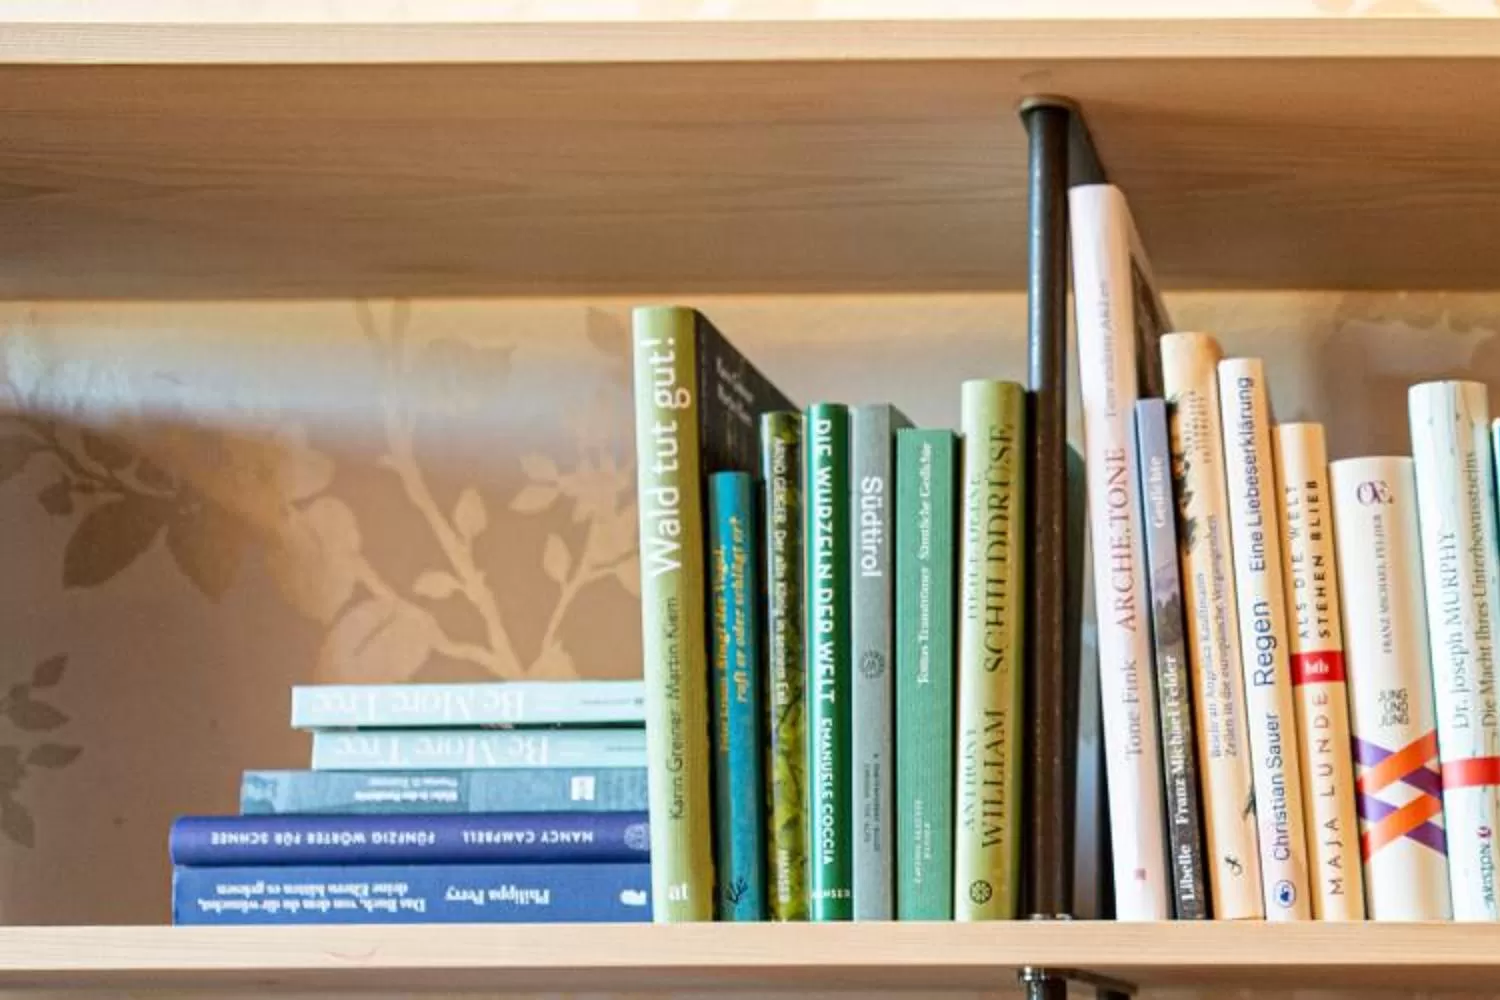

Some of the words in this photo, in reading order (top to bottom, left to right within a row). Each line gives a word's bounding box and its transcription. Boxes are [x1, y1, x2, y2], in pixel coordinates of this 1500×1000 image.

[641, 337, 690, 409] gut!
[648, 422, 679, 474] tut
[815, 418, 833, 457] DIE
[1236, 376, 1264, 528] Liebeserklärung
[646, 485, 680, 578] Wald
[815, 465, 834, 579] WURZELN
[860, 476, 884, 577] Südtirol
[1285, 485, 1298, 543] WELT
[1306, 480, 1323, 541] BLIEB
[982, 422, 1015, 673] SCHILDDRÜSE
[1103, 447, 1138, 633] ARCHE.TONE
[1247, 530, 1265, 572] Eine
[1290, 555, 1306, 590] DIE
[1312, 554, 1330, 639] STEHEN
[1438, 530, 1463, 628] MURPHY
[816, 587, 834, 634] DER
[1294, 602, 1310, 639] ALS
[1472, 601, 1491, 640] Ihres
[1252, 601, 1278, 687] Regen
[1446, 631, 1471, 694] Joseph
[664, 644, 681, 700] Martin
[817, 641, 836, 704] WELT
[1120, 659, 1140, 705] Fink
[1162, 655, 1180, 707] Felder
[1477, 645, 1497, 696] Macht
[1124, 712, 1143, 759] Tone
[1450, 700, 1470, 729] Dr.
[1480, 700, 1499, 729] Die
[665, 710, 683, 772] Greiner
[818, 717, 834, 800] EMANUELE
[1166, 709, 1187, 775] Michael
[1264, 712, 1283, 769] Sauer
[1313, 692, 1336, 798] LUNDE
[667, 777, 684, 821] Karin
[963, 728, 977, 831] ANTHONY
[981, 708, 1006, 849] WILLIAM
[1173, 777, 1190, 825] Franz
[211, 831, 269, 846] SCHNEE
[274, 831, 302, 847] FÜR
[307, 831, 366, 847] WÖRTER
[372, 831, 436, 846] FÜNFZIG
[462, 830, 536, 844] CAMPBELL
[540, 830, 594, 844] NANCY
[820, 803, 836, 865] COCCIA
[1271, 774, 1291, 861] Christian
[1177, 845, 1195, 901] Libelle
[1323, 818, 1345, 896] MAJA
[283, 898, 301, 913] du
[302, 898, 331, 913] dem
[333, 898, 358, 909] von
[371, 883, 409, 897] deine
[400, 898, 427, 912] Das
[444, 885, 485, 905] Perry
[488, 884, 551, 905] Philippa
[667, 883, 688, 900] at
